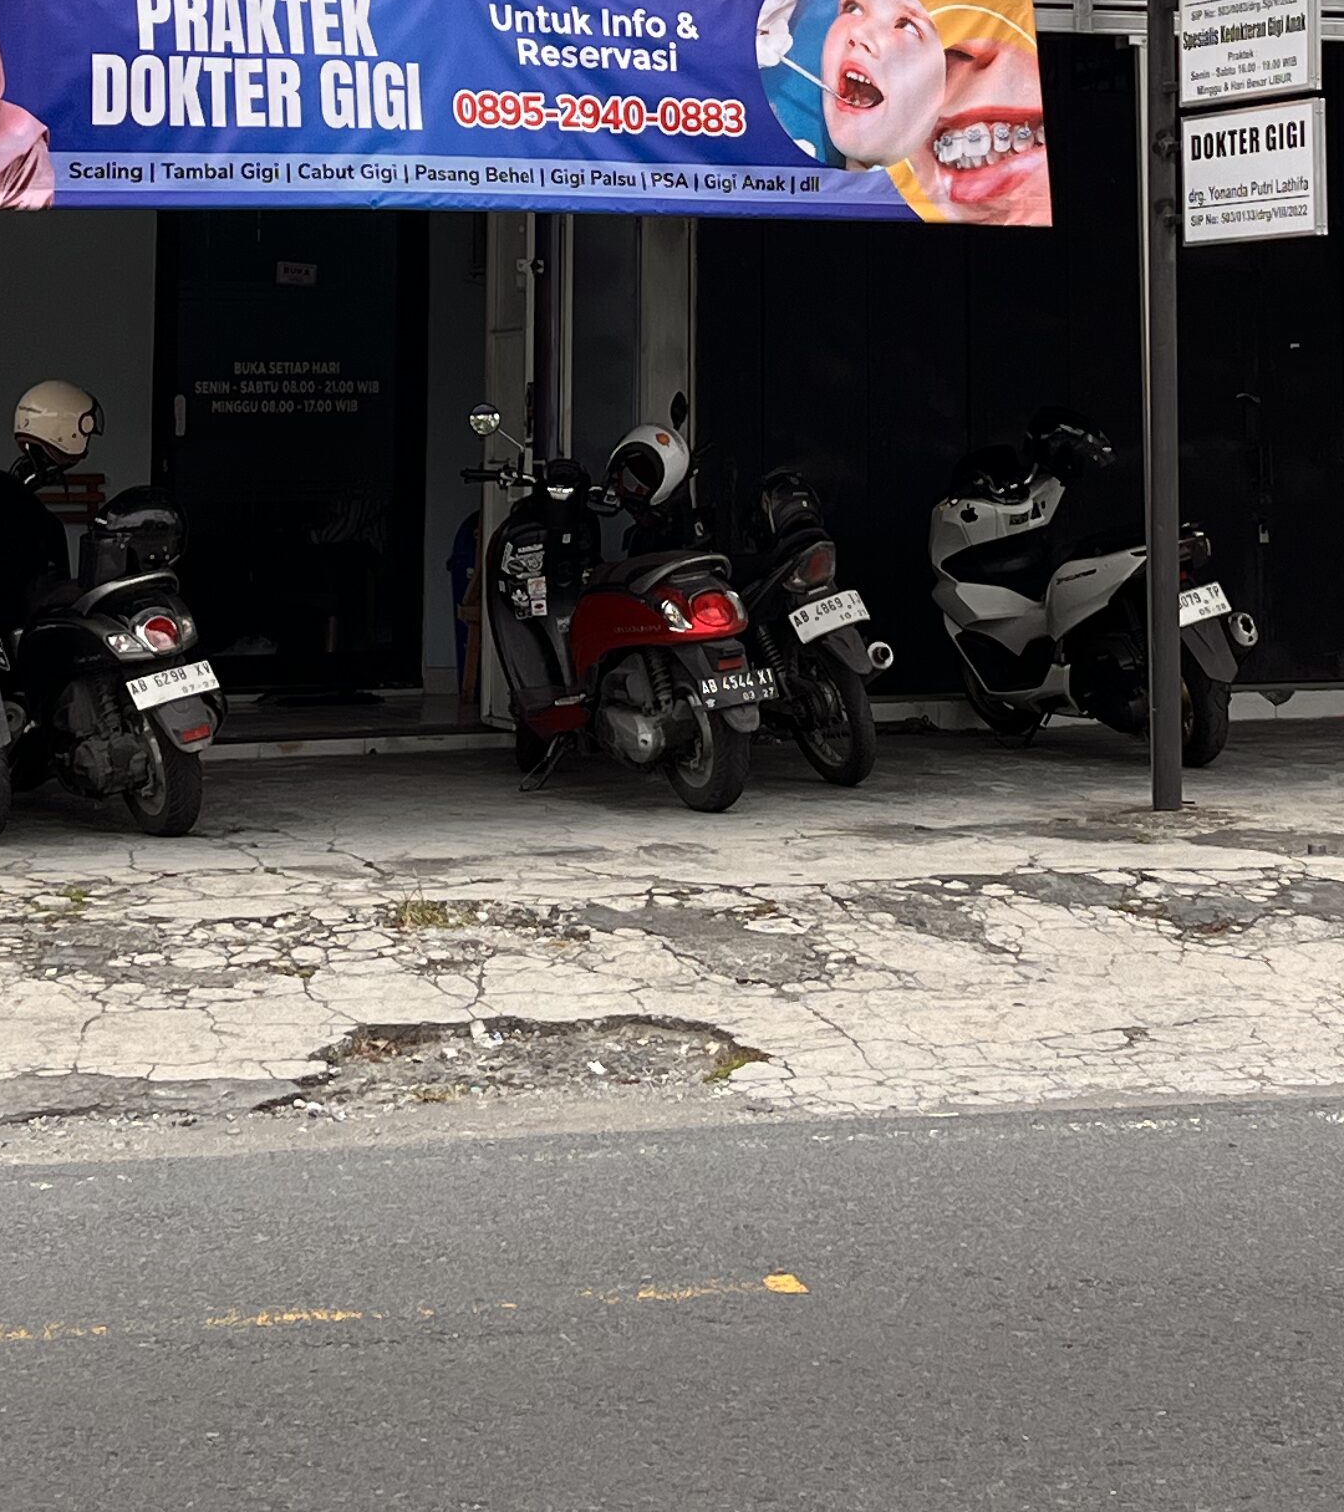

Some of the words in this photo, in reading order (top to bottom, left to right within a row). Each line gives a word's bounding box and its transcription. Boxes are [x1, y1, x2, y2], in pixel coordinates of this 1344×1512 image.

[489, 3, 591, 36] Untuk
[601, 7, 666, 39] Info
[675, 12, 699, 40] &
[1267, 15, 1284, 37] Gigi
[517, 38, 677, 72] Reservasi
[91, 54, 302, 128] DOKTER
[320, 60, 424, 131] GIGI
[453, 88, 746, 138] 0895-2940-0883
[1191, 127, 1260, 161] DOKTER
[1265, 120, 1306, 151] GIGI
[69, 162, 143, 183] Scaling
[162, 162, 233, 180] Tambal
[241, 162, 280, 183] Gigi
[298, 163, 355, 180] Cabut
[361, 164, 397, 184] Gigi
[415, 165, 479, 185] Pasang
[486, 167, 534, 184] Behel
[551, 169, 585, 187] Gigi
[591, 170, 636, 187] Palsu
[651, 174, 688, 189] PSA
[704, 174, 737, 193] Gigi
[742, 175, 785, 191] Anak
[800, 176, 819, 192] dll
[1188, 187, 1206, 207] drg.
[1208, 184, 1248, 201] Yonanda
[1251, 179, 1274, 197] Putri
[1276, 176, 1309, 193] Lathifa
[1191, 215, 1204, 226] SIP
[233, 361, 267, 374] BUKA
[268, 361, 310, 374] SETIAP
[312, 361, 341, 374] HARI
[194, 380, 230, 394] SENIN
[239, 380, 279, 393] SABTU
[282, 380, 316, 393] 08.00
[324, 380, 354, 393] 21.00
[357, 380, 380, 393] WIB
[211, 400, 258, 414] MINGGU
[261, 400, 294, 413] 08.00
[304, 399, 332, 412] 17.00
[335, 399, 358, 412] WIB
[1206, 585, 1219, 599] TP
[793, 610, 810, 627] AB
[130, 679, 148, 695] AB
[154, 668, 187, 687] 6298
[702, 679, 718, 694] AB
[722, 672, 753, 690] 4544
